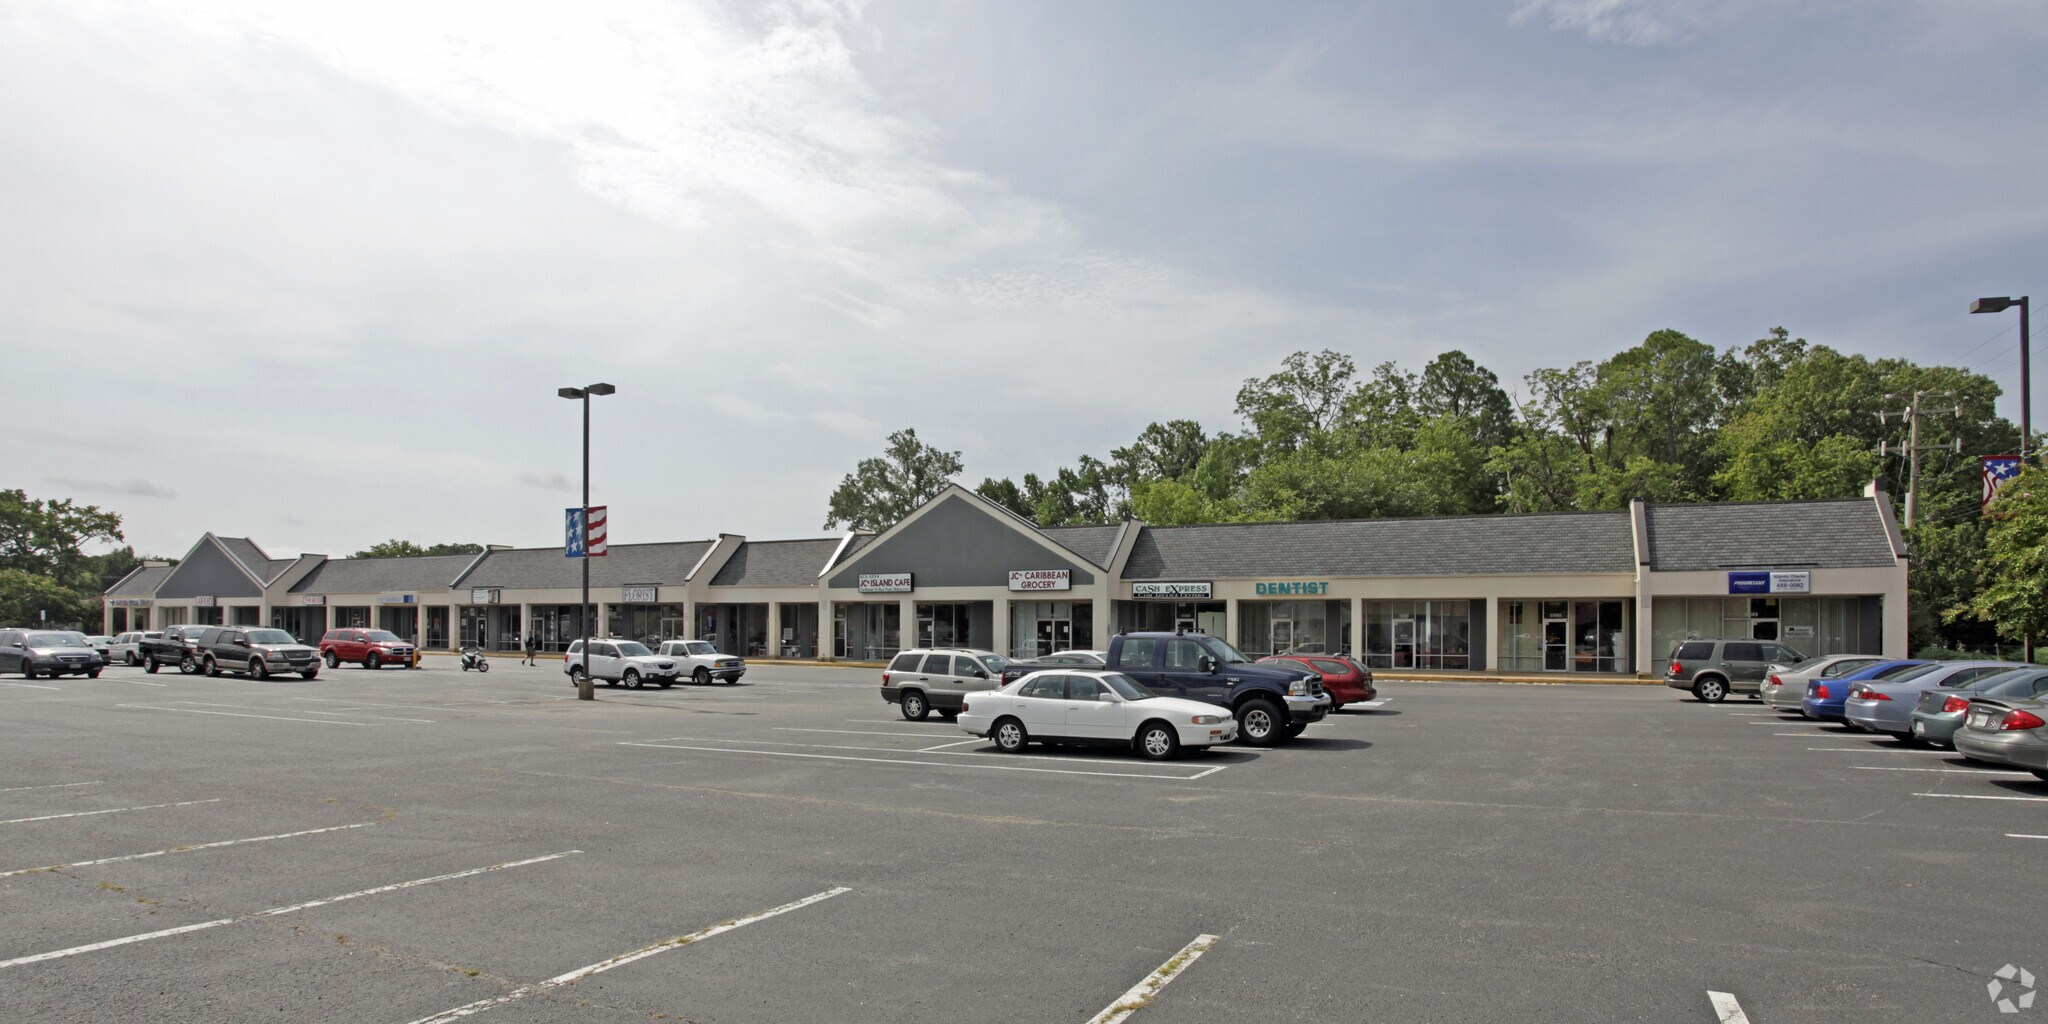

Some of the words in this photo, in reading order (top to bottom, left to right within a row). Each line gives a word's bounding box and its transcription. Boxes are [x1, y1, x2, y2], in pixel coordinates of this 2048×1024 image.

[1024, 571, 1068, 579] CARIBBEAN
[1165, 585, 1207, 593] EXPRESS
[1256, 582, 1328, 594] DENTIST
[624, 589, 655, 601] FLORIST
